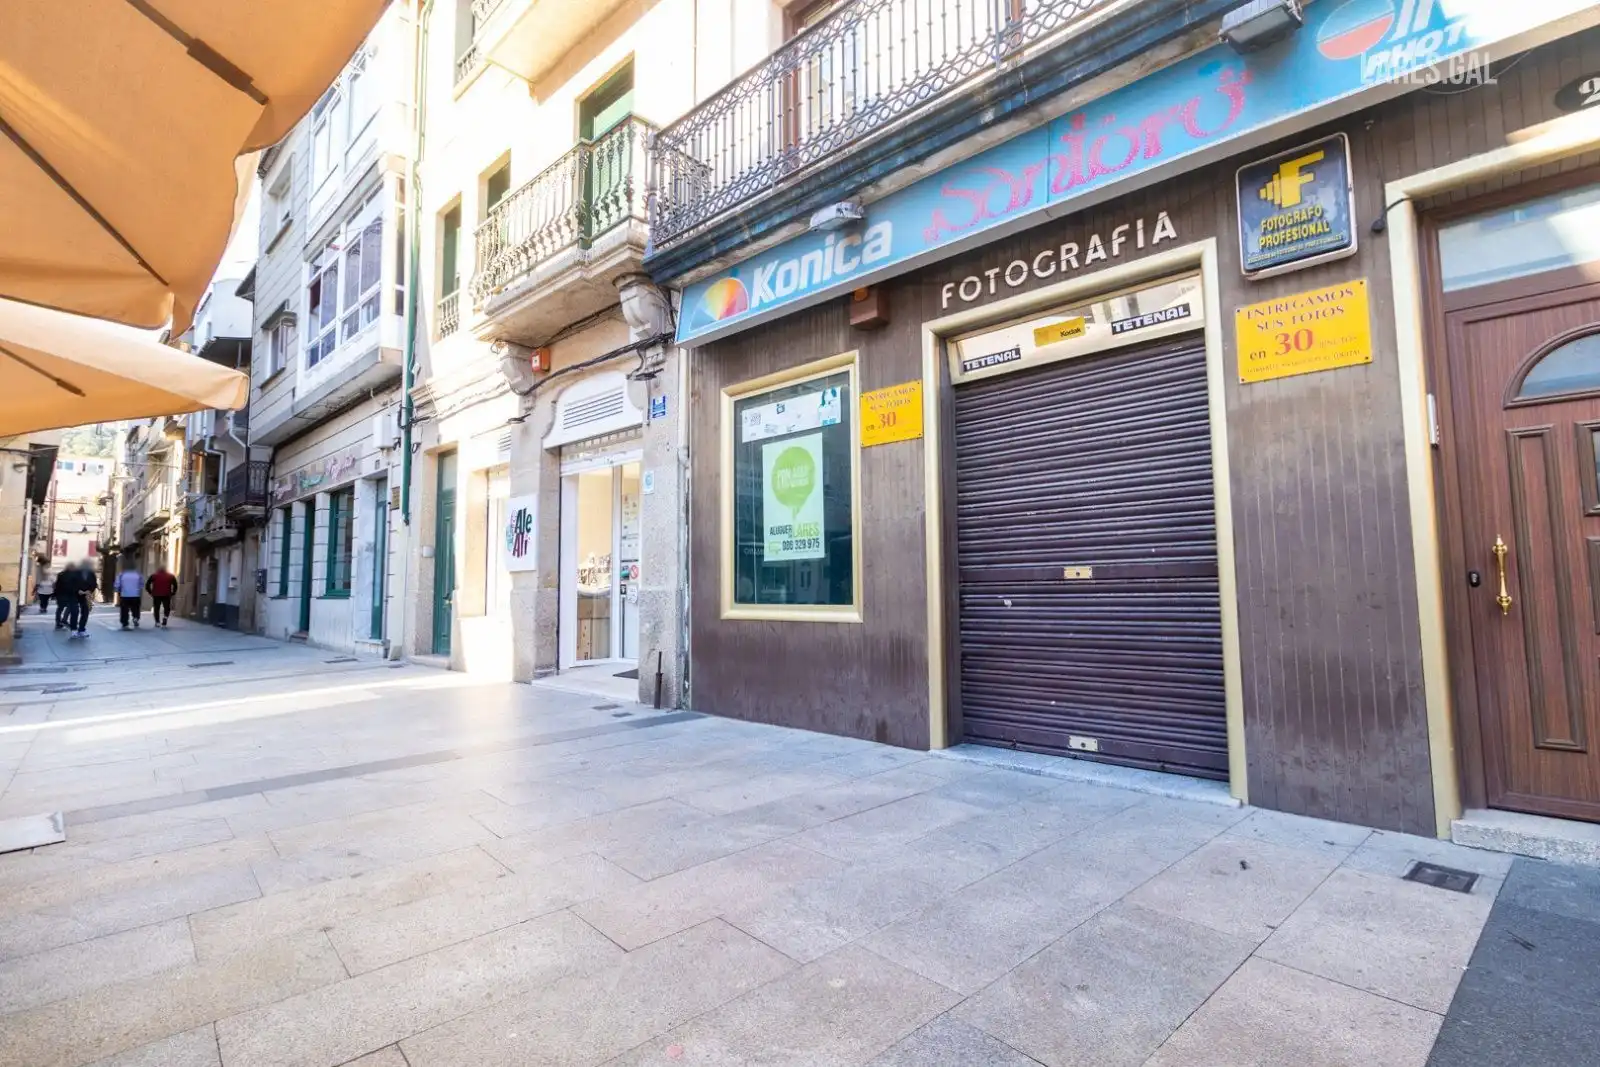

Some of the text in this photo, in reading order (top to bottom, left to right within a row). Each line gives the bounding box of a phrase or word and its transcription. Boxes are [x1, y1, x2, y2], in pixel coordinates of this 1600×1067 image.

[1261, 205, 1322, 232] FOTOGRAFO
[1259, 221, 1330, 249] PROFESIONAL
[751, 219, 893, 307] Konica
[941, 211, 1178, 309] FOTOGRAFIA
[1060, 326, 1082, 338] Kodak
[1112, 306, 1190, 333] TETENAL
[1249, 350, 1267, 361] en
[1275, 328, 1314, 356] 30
[963, 350, 1020, 372] TETENAL
[880, 412, 897, 429] 30
[514, 507, 533, 534] Ale
[794, 539, 807, 551] 329
[807, 538, 820, 549] 975
